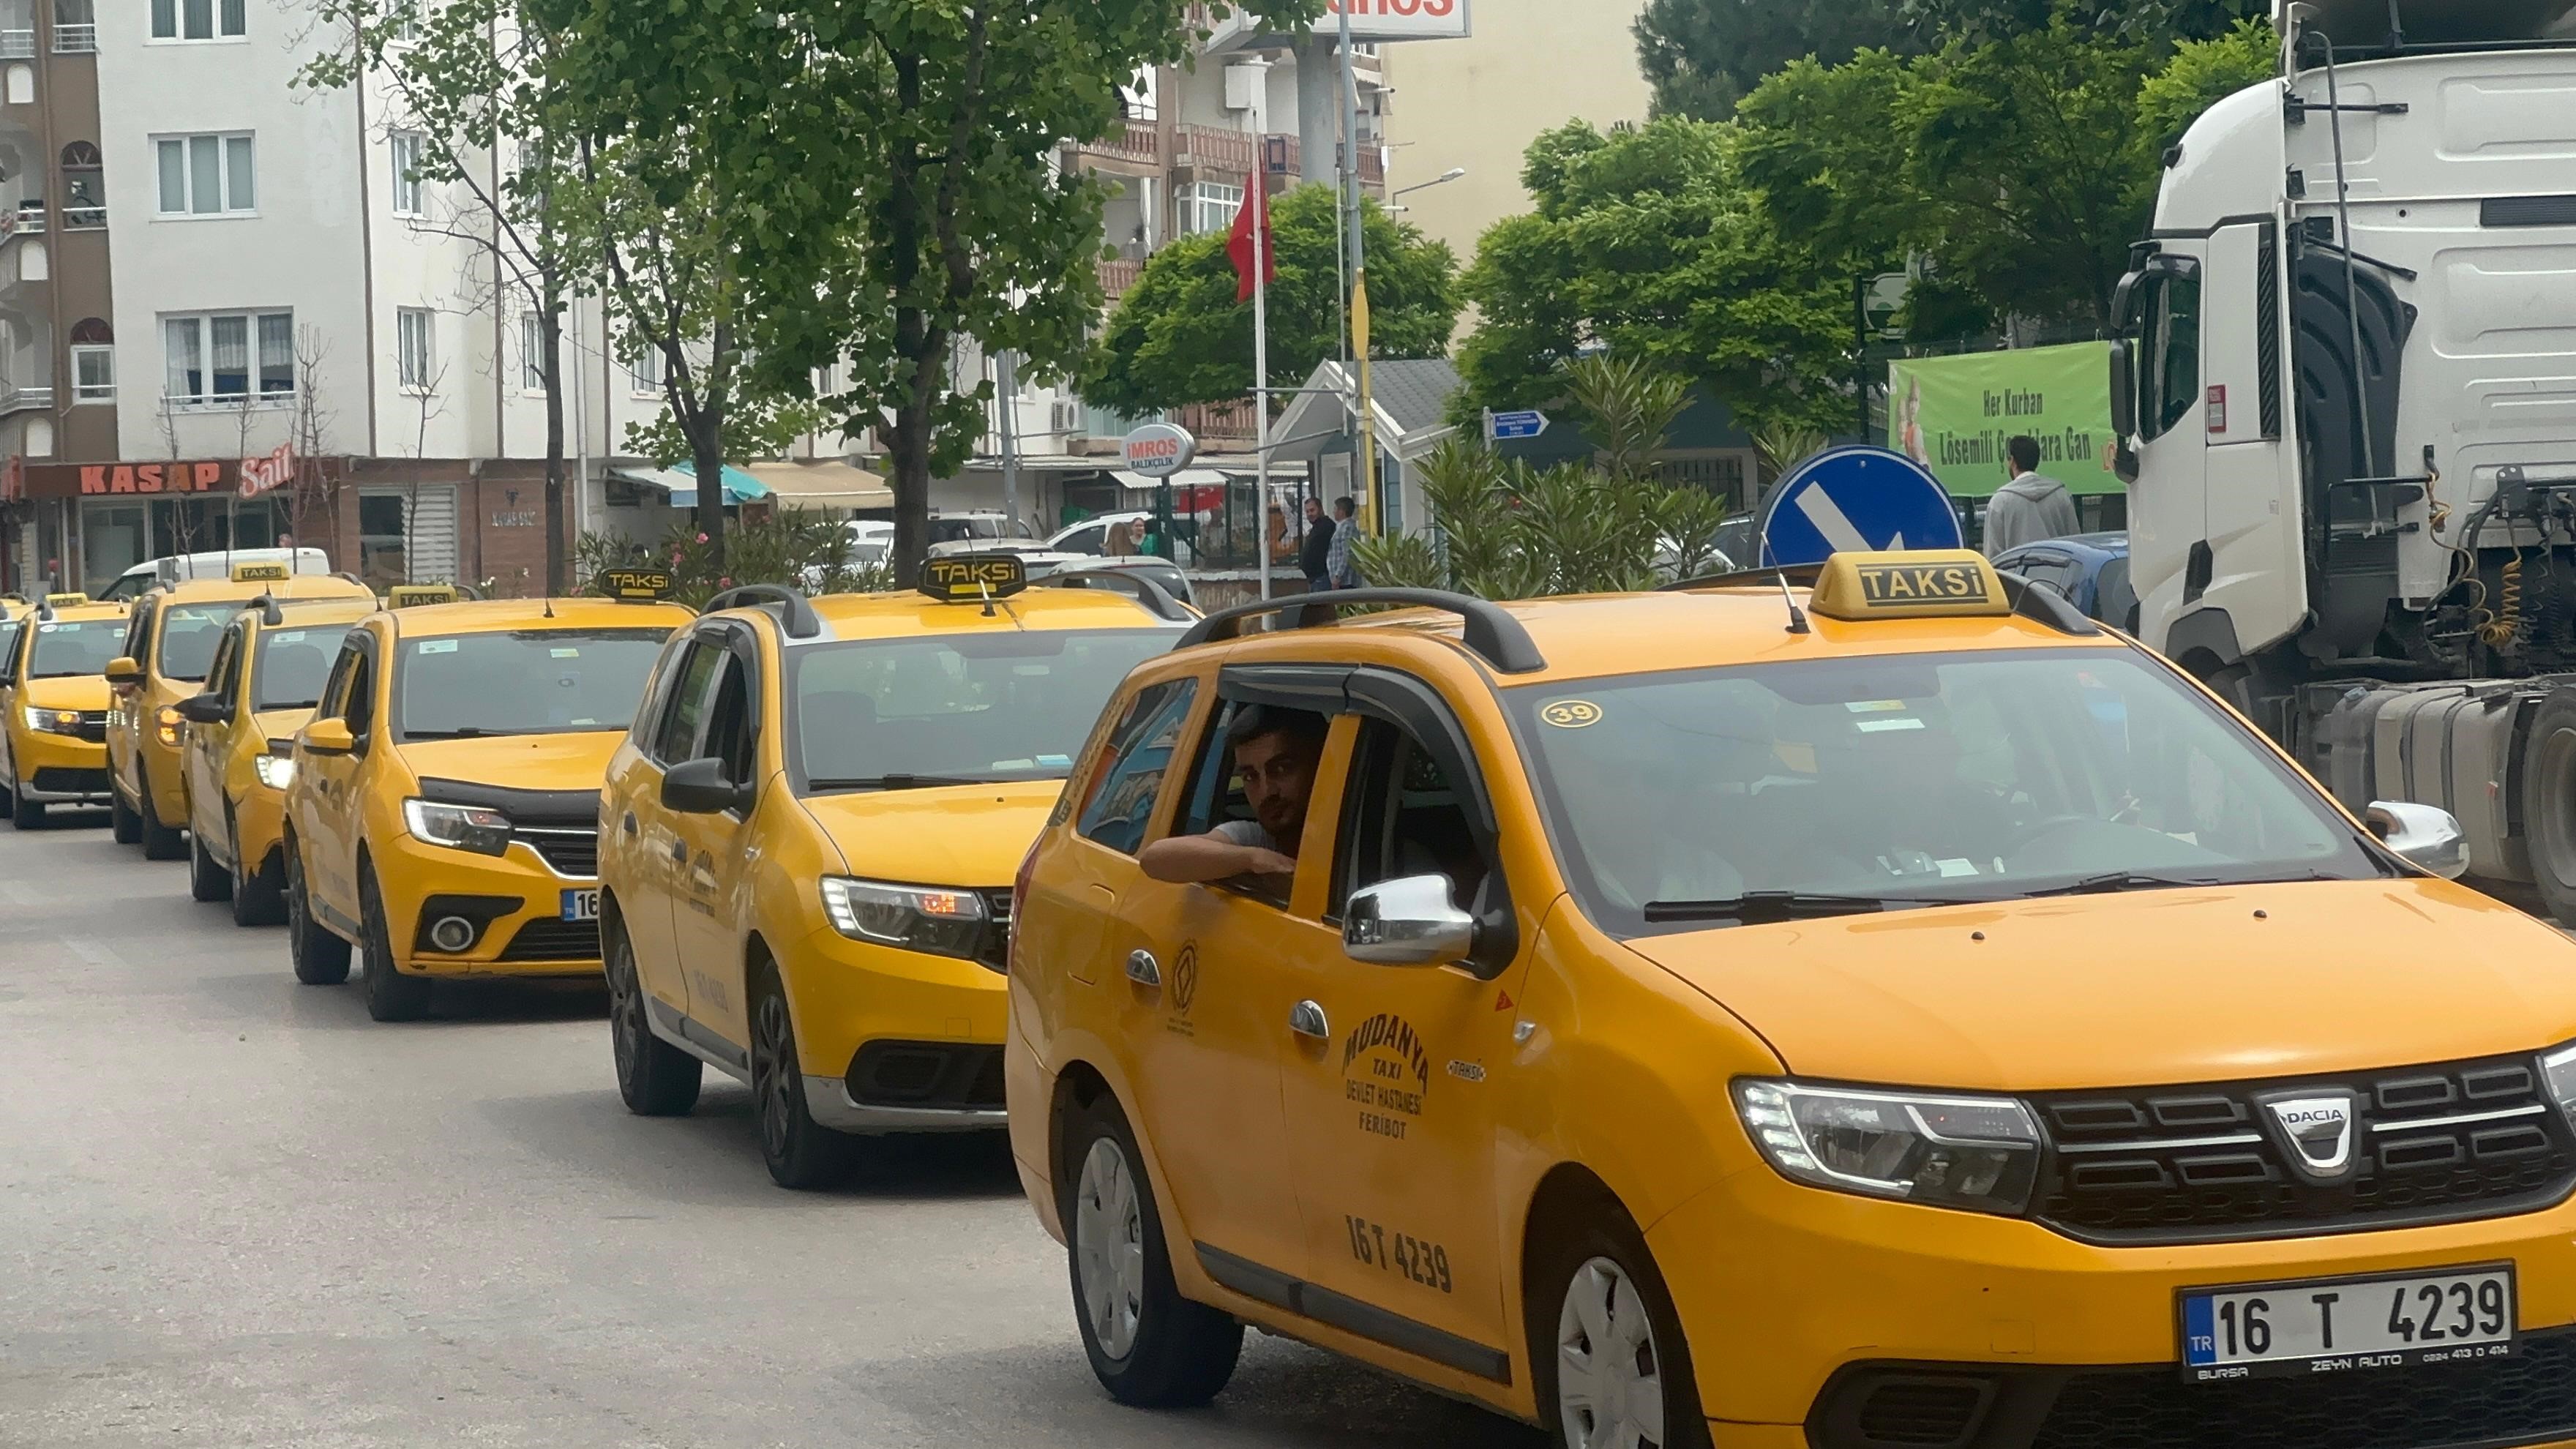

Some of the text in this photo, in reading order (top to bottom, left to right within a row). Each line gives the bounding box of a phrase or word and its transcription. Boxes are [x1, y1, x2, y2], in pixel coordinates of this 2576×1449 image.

[1984, 387, 2043, 417] Her Kurban
[1939, 430, 1993, 465] Lösemili
[2066, 426, 2092, 461] Can
[80, 463, 220, 493] KASAP
[1550, 705, 1593, 722] 39
[577, 893, 598, 916] 16
[1341, 1014, 1429, 1097] MUDANYA
[1373, 1058, 1402, 1080] TAXI
[1347, 1079, 1376, 1106] DEVLET
[2287, 1109, 2343, 1123] DACIA
[1346, 1214, 1452, 1294] 16 T 4239
[2220, 1279, 2504, 1355] 16 T 4239
[2190, 1336, 2212, 1352] TR
[2423, 1354, 2449, 1362] 0224
[2452, 1349, 2471, 1358] 413
[2489, 1346, 2508, 1355] 414
[2198, 1367, 2248, 1379] BURSA
[2311, 1355, 2403, 1371] ZEYN AUTO
